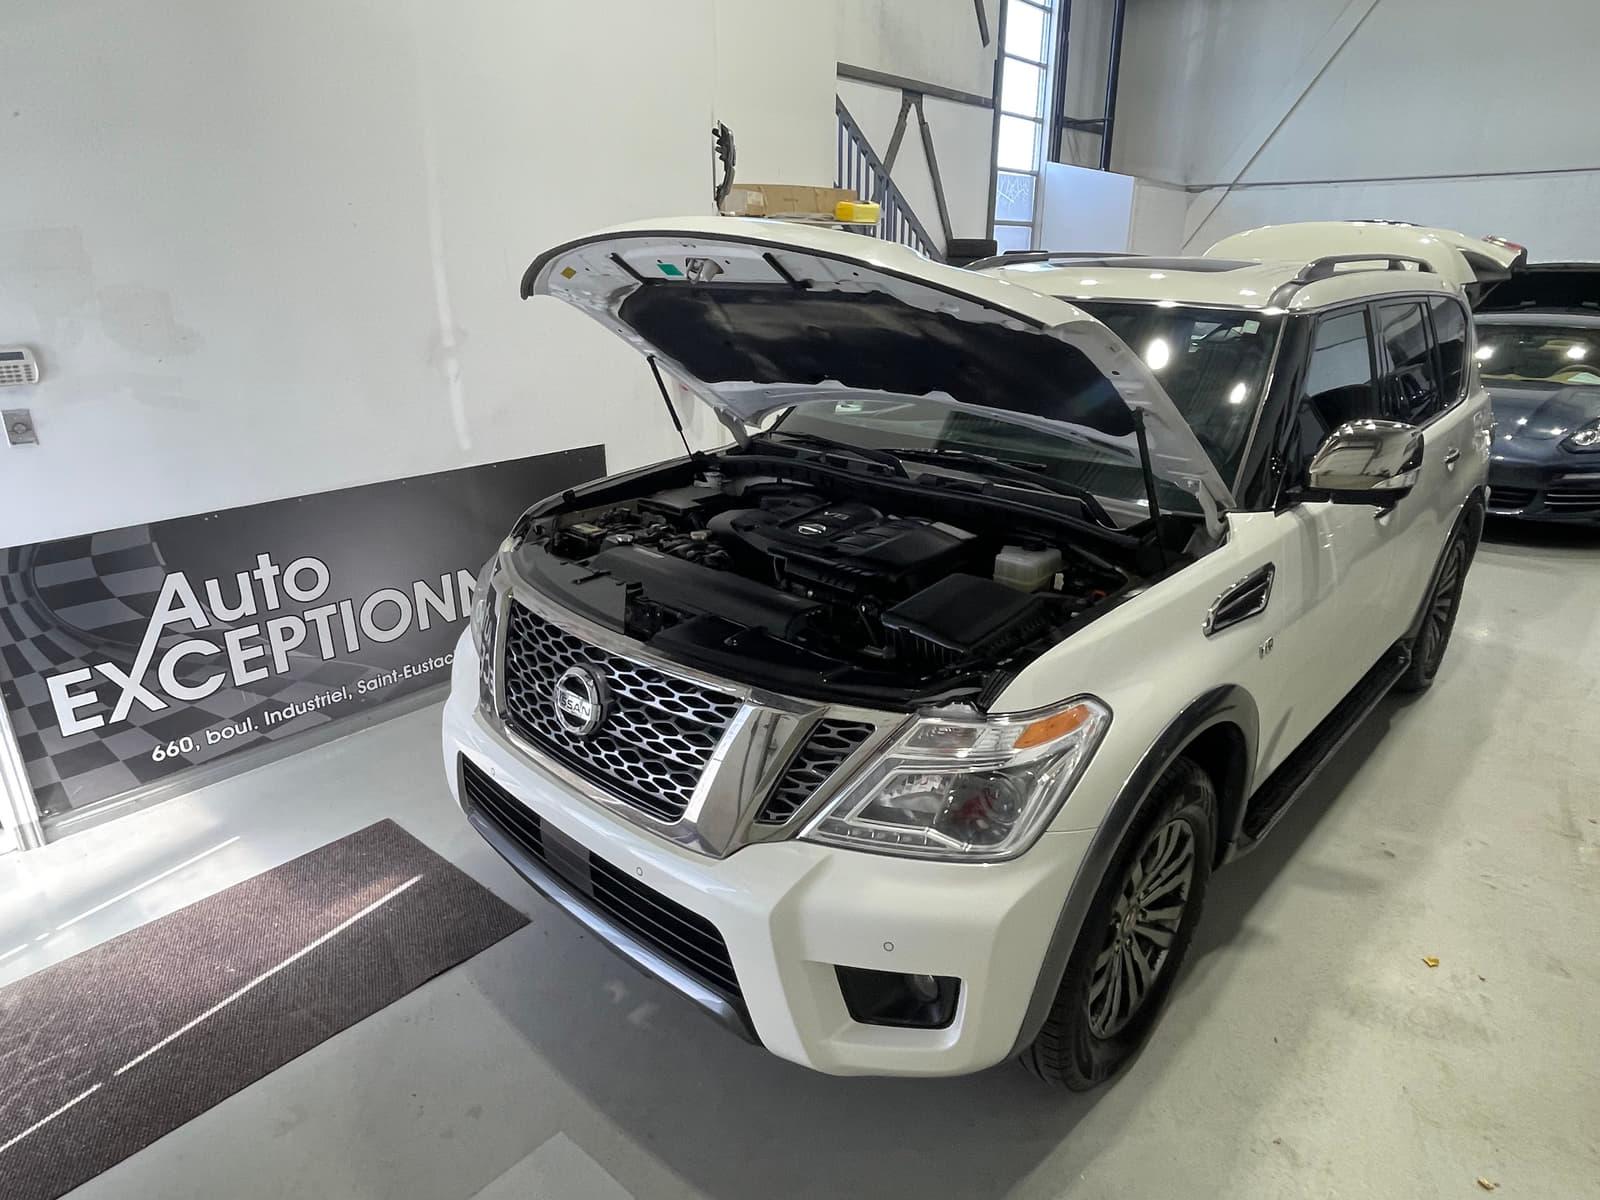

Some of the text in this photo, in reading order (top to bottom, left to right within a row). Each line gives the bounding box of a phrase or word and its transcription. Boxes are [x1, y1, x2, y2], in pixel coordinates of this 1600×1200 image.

[163, 553, 330, 632] Auto
[150, 650, 456, 763] 660, boul. Industriel, Saint-Eustac
